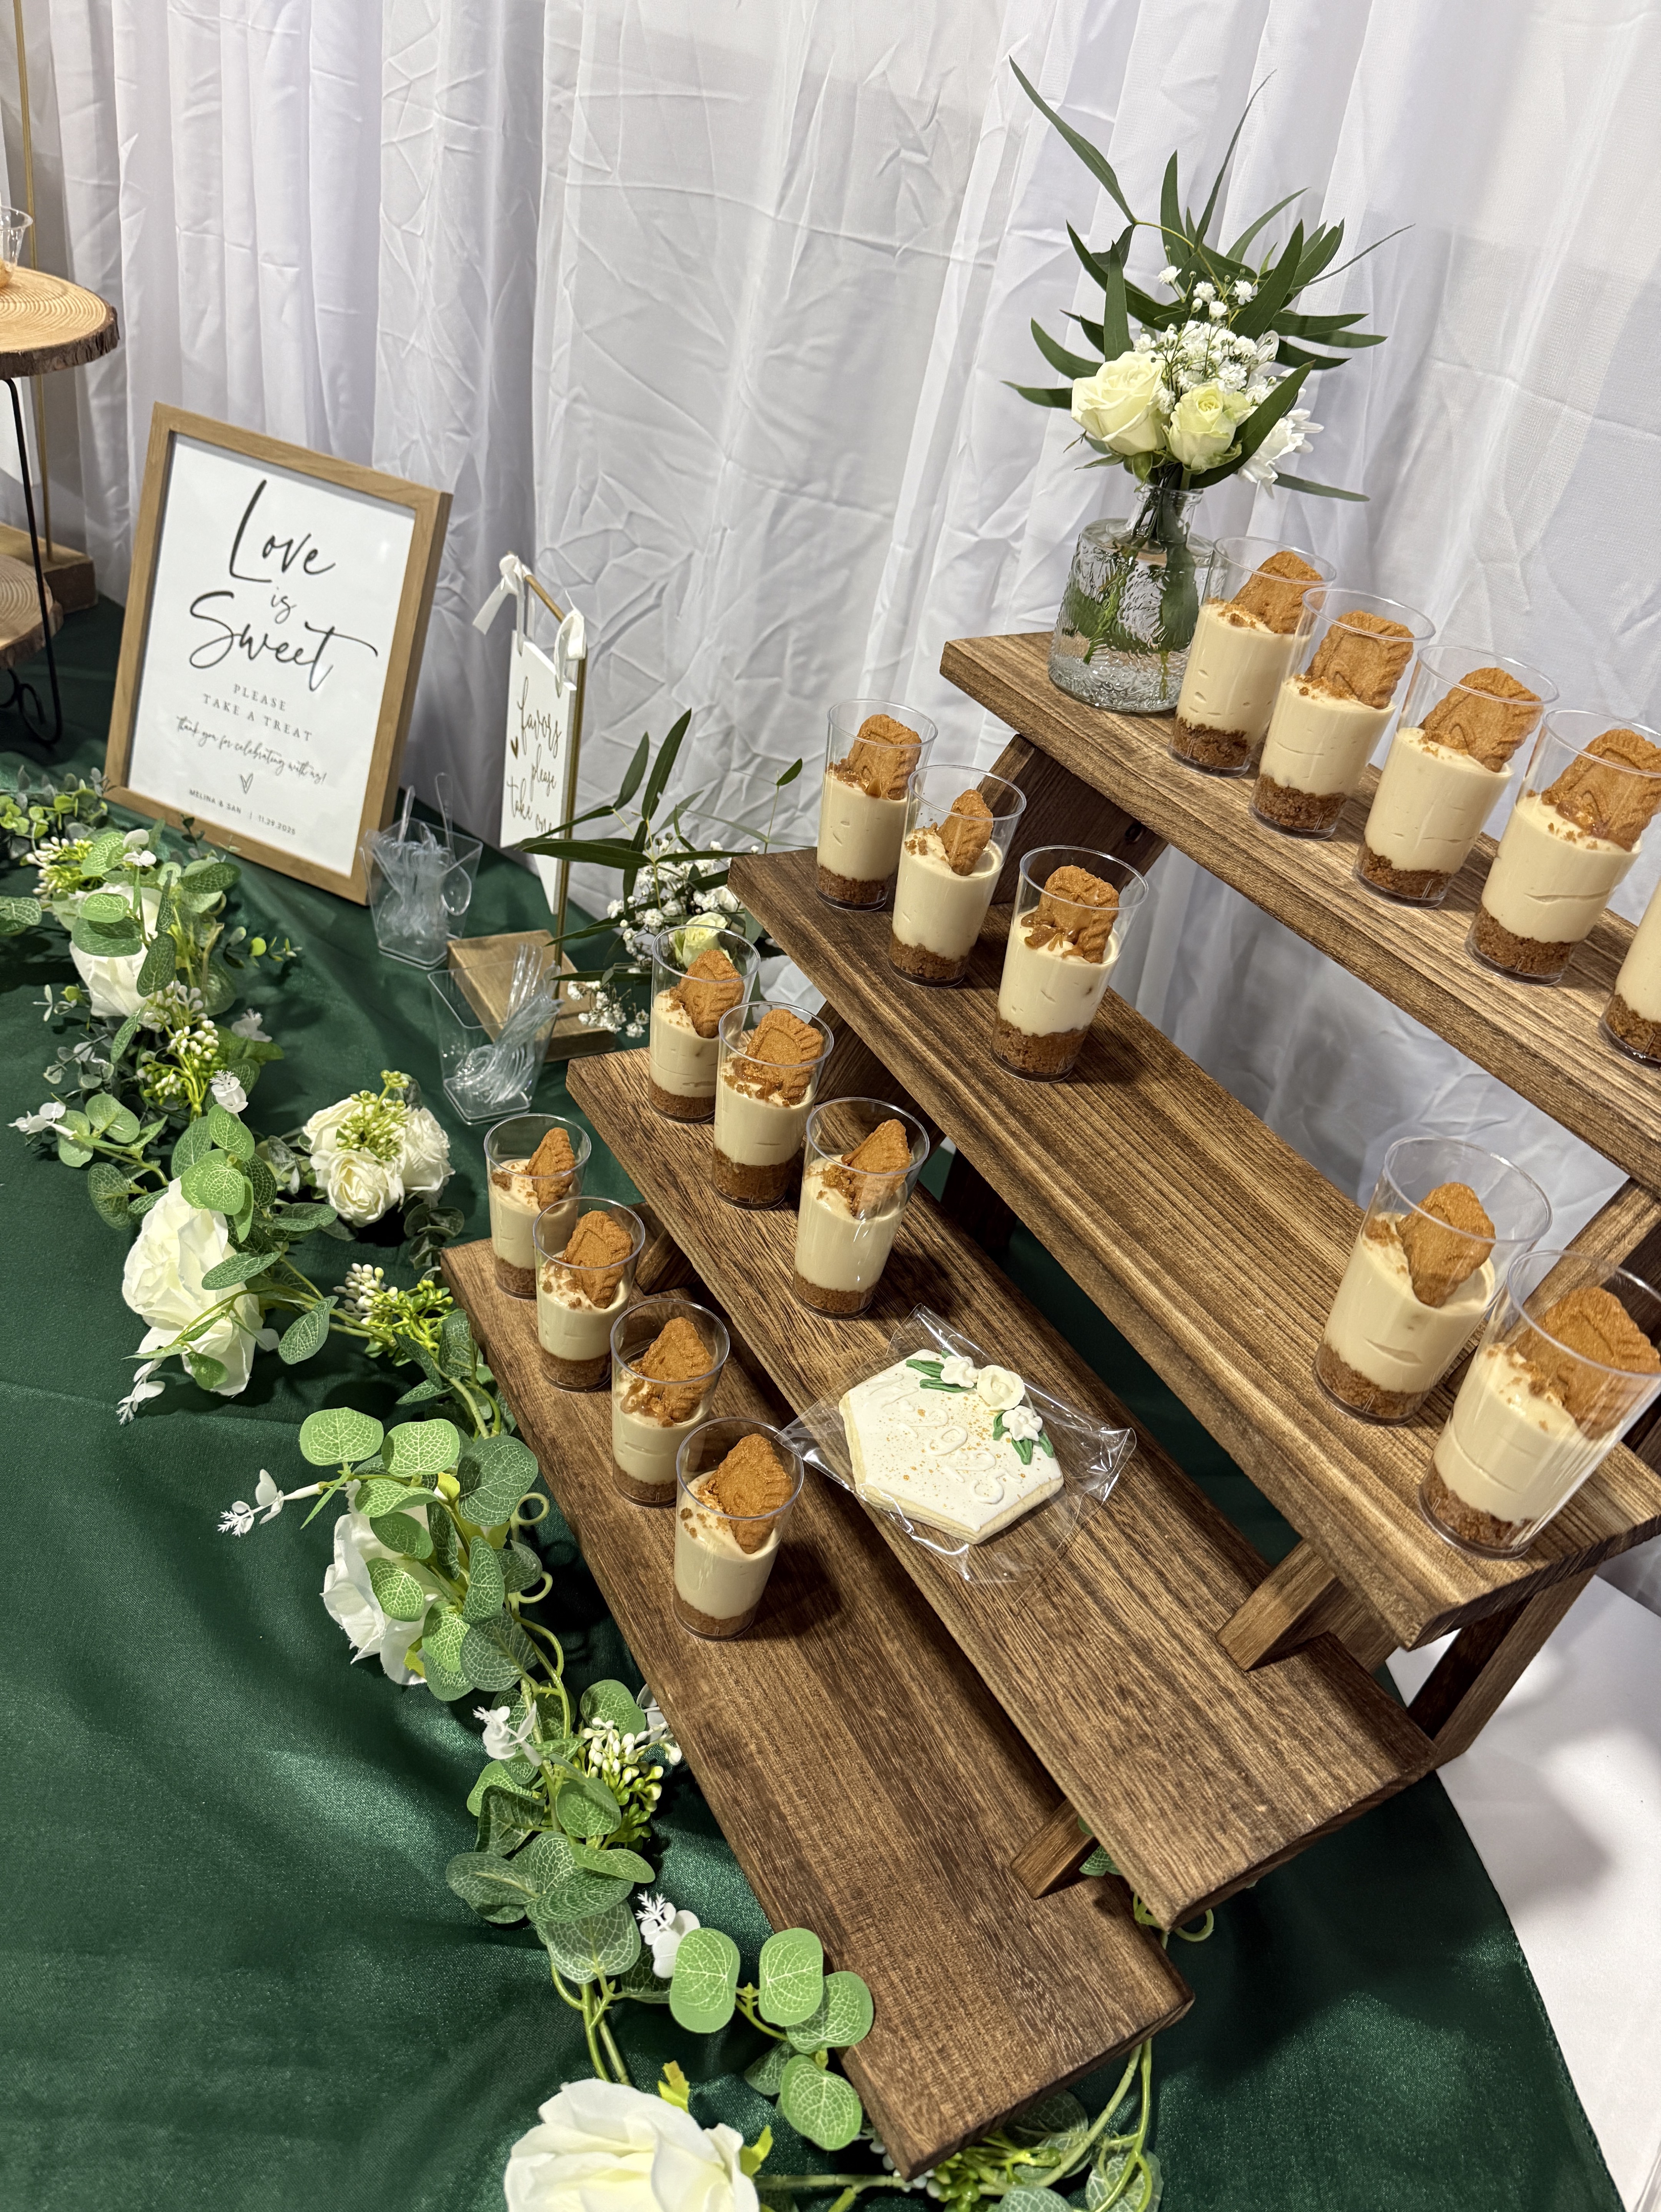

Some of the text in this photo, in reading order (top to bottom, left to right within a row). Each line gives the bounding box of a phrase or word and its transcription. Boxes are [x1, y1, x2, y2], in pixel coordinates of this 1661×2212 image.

[230, 480, 336, 582] Love
[271, 587, 296, 624] is
[190, 590, 378, 691] Sweet
[203, 693, 312, 741] TAKE A TREAT
[233, 683, 286, 711] PLEASE
[517, 676, 562, 759] favors
[198, 732, 218, 747] you
[219, 735, 231, 750] for
[234, 740, 284, 776] celebrating
[288, 760, 314, 777] with
[530, 744, 556, 802] please
[189, 788, 215, 803] MELINA
[507, 776, 533, 820] take
